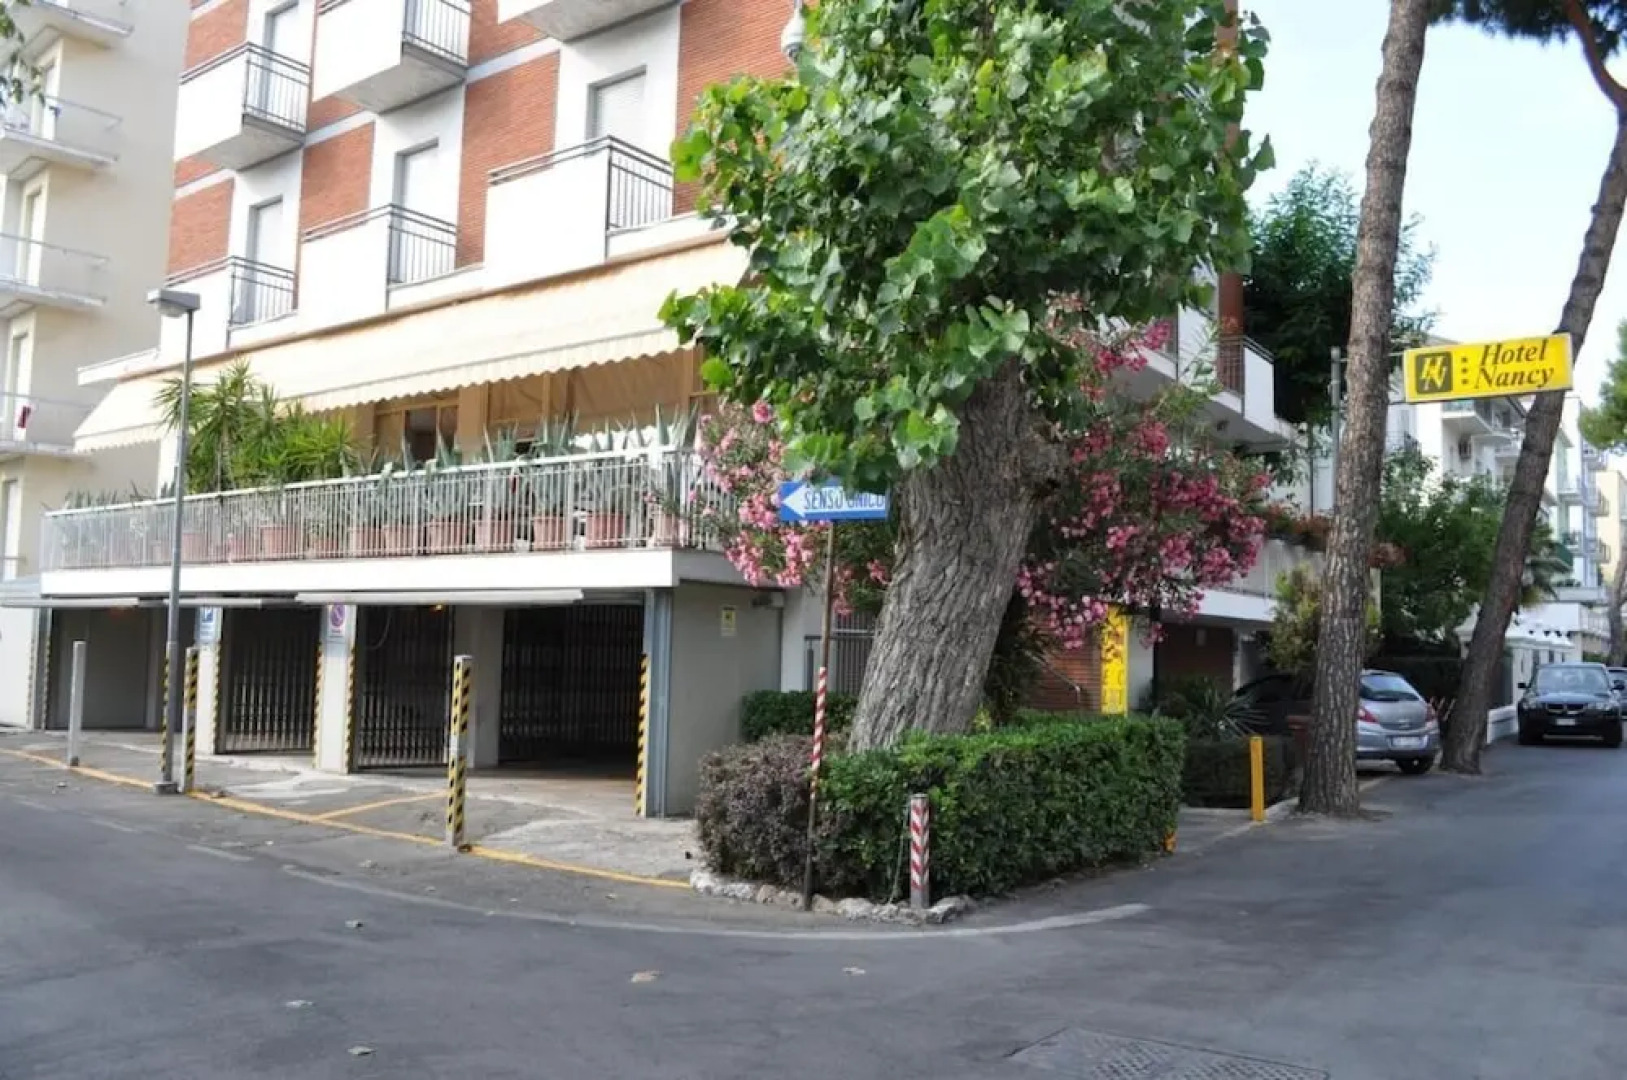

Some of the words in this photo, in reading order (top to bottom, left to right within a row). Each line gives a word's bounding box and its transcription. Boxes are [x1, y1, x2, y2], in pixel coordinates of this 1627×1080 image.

[1480, 338, 1549, 368] Hotel
[1474, 366, 1555, 389] Nancy
[803, 489, 844, 510] SENSO
